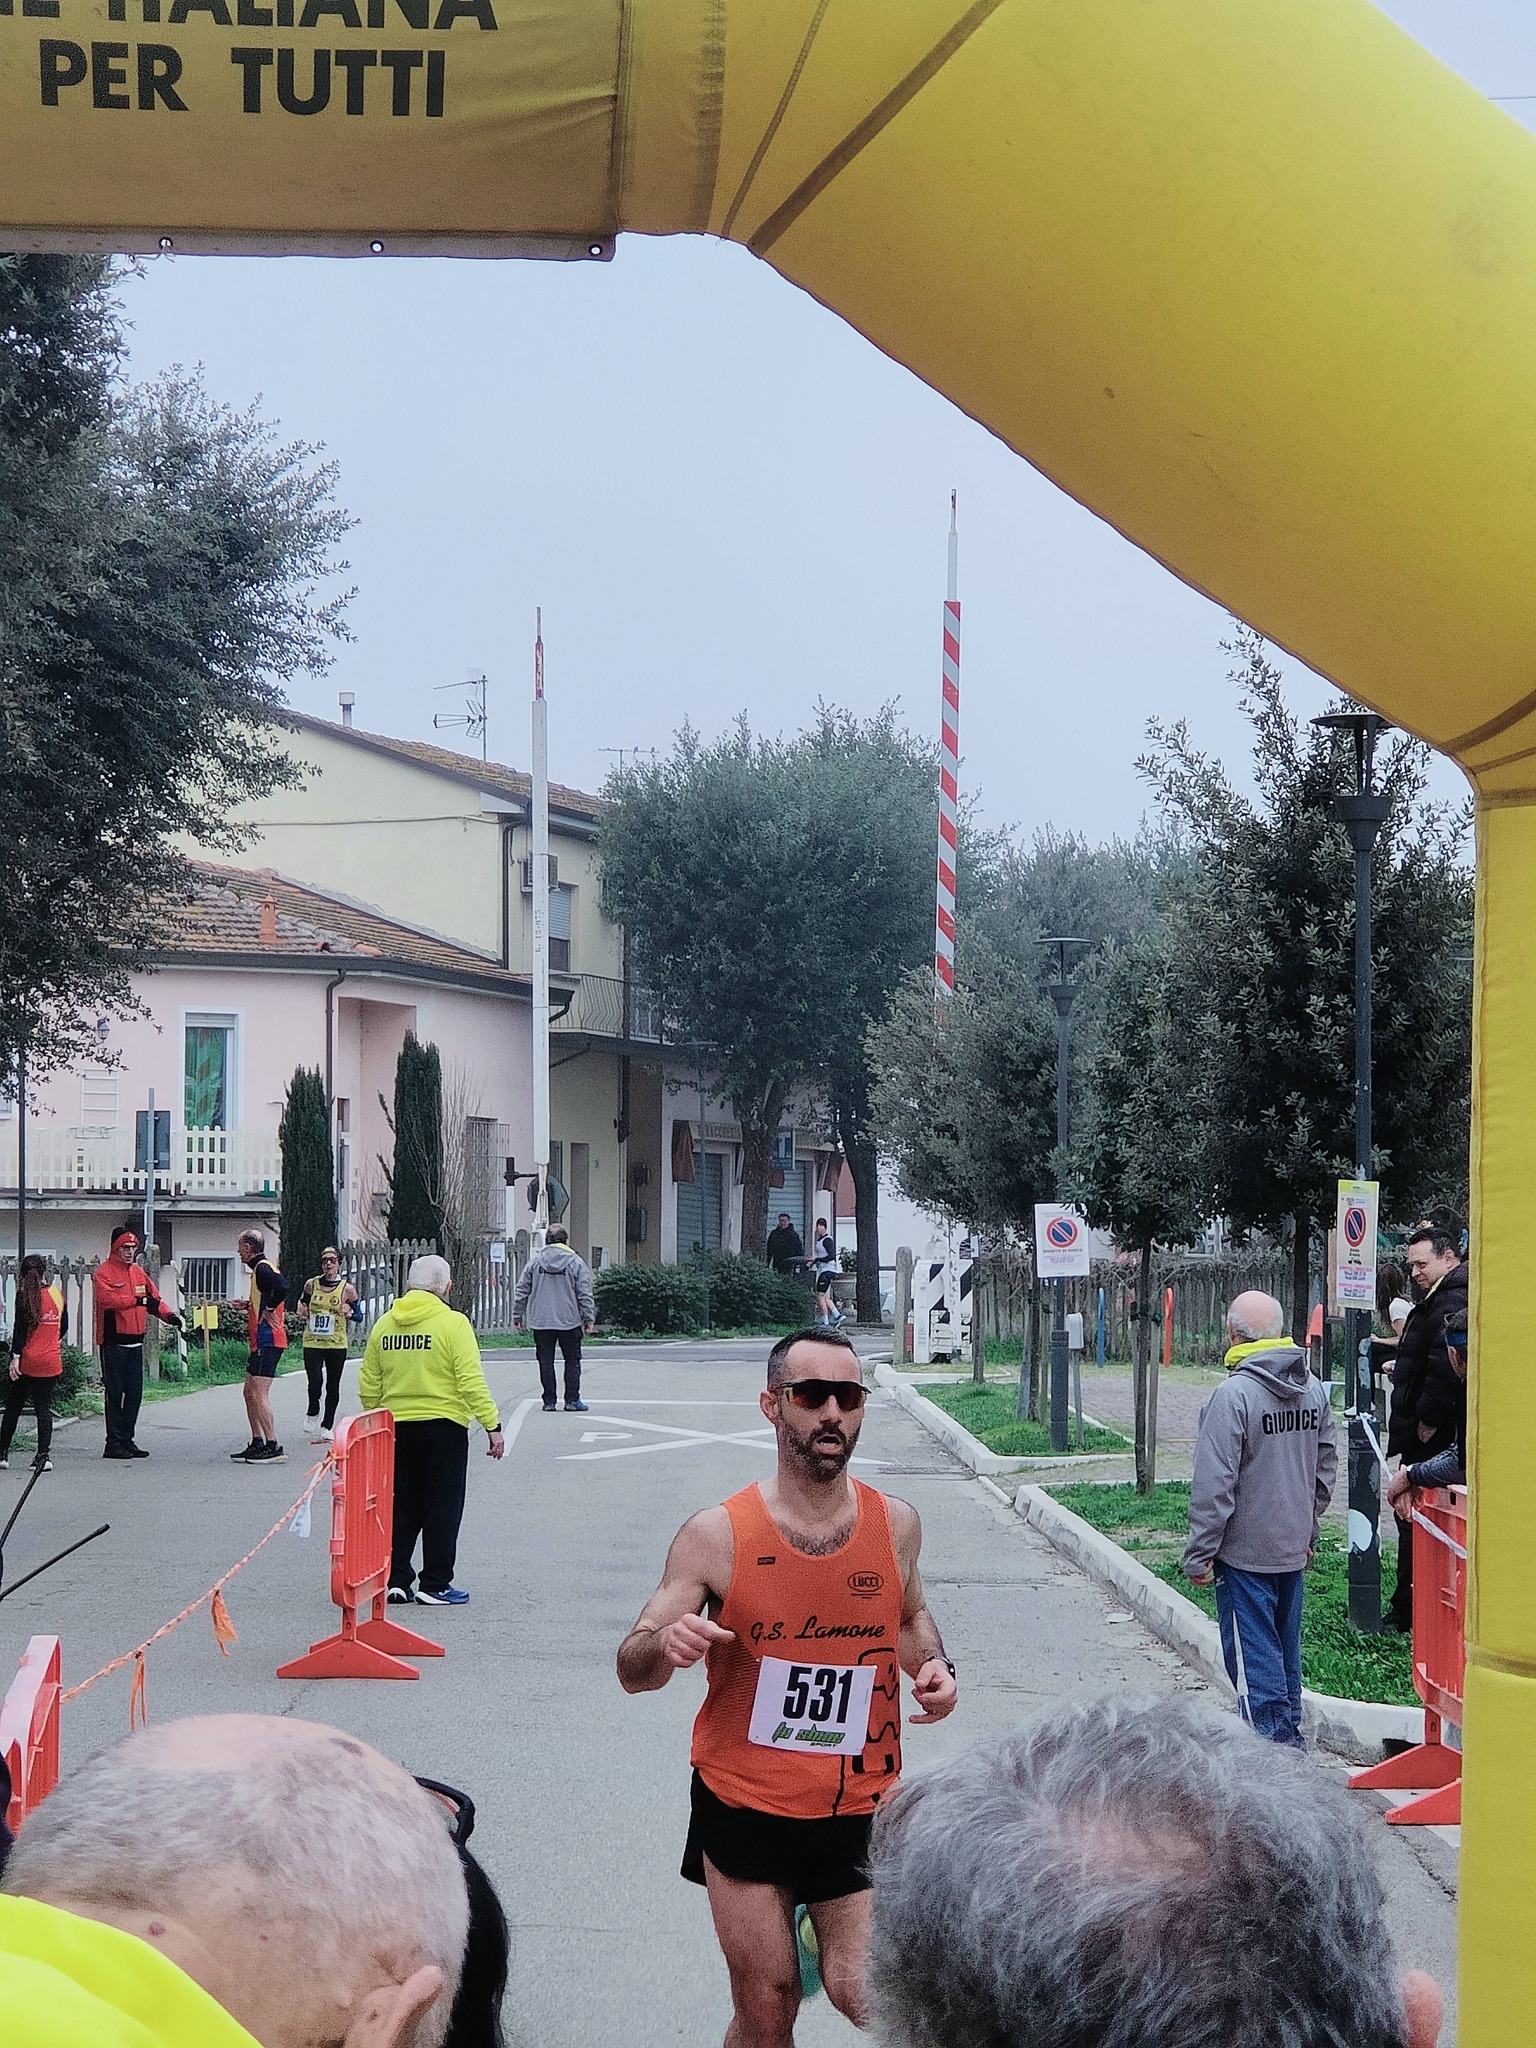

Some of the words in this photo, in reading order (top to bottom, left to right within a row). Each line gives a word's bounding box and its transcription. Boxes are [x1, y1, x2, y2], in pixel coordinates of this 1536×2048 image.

[39, 38, 190, 112] PER
[230, 47, 446, 117] TUTTI
[382, 1334, 432, 1351] GIUDICE
[1261, 1408, 1318, 1435] GIUDICE
[852, 1575, 879, 1588] LUCCI
[750, 1621, 787, 1646] G.S.
[794, 1615, 886, 1640] Lamone
[782, 1665, 854, 1724] 531
